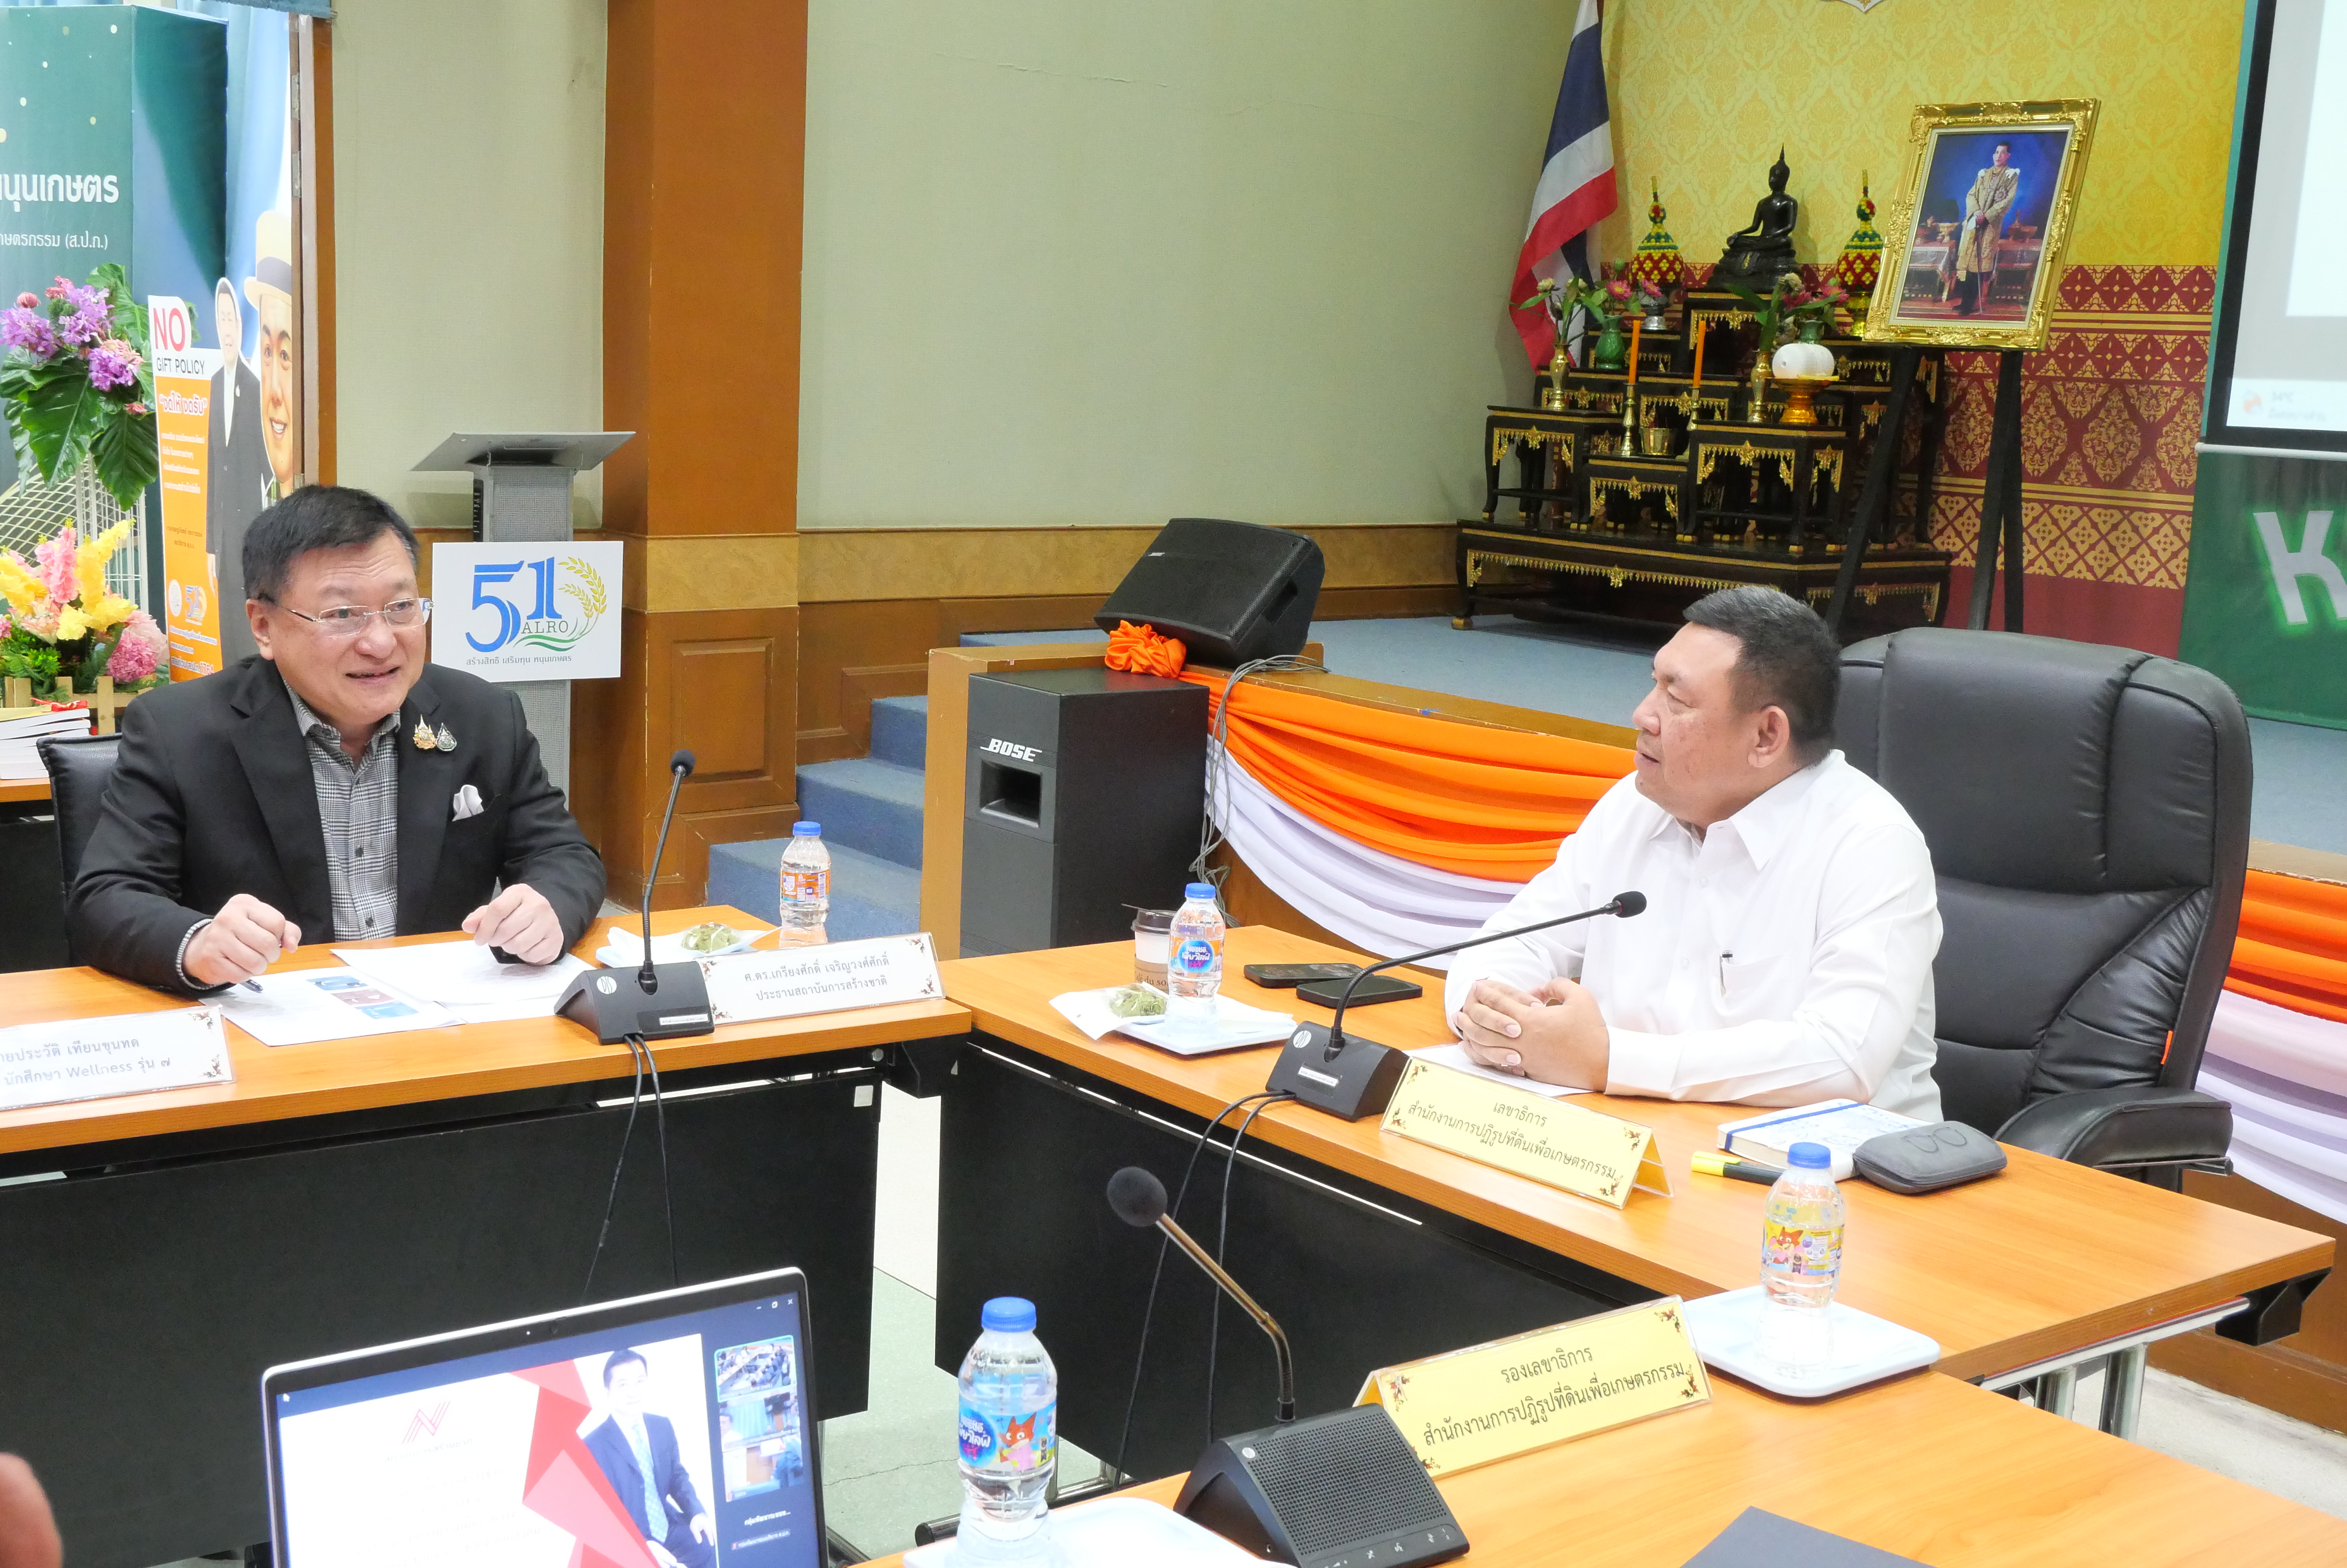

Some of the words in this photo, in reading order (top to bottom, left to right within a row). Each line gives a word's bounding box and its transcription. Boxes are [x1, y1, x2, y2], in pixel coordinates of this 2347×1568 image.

[0, 174, 119, 212] นุนเกษตร
[65, 231, 108, 250] (ส.ป.ก.)
[153, 307, 186, 352] NO
[156, 357, 172, 372] GIFT
[175, 358, 205, 375] POLICY
[465, 556, 562, 652] 51
[521, 620, 568, 634] ALRO
[466, 656, 499, 666] สร้างสิทธิ
[503, 656, 530, 665] เสริมทุน
[534, 655, 572, 665] หนุนเกษตร
[980, 738, 1043, 762] BOSE
[744, 959, 821, 981] ศ.ดร.เกรียงศักดิ์
[825, 951, 890, 974] เจริญวงศ์ศักดิ์
[756, 974, 888, 1001] ประธานสถาบันการสร้างชาติ
[67, 1038, 140, 1056] เทียนขุนทด
[4, 1069, 61, 1086] นักศึกษา
[66, 1063, 133, 1078] Wellness
[138, 1057, 155, 1073] รุ่น
[161, 1057, 171, 1068] ๗
[1493, 1102, 1548, 1127] เลขาธิการ
[1407, 1100, 1617, 1179] สำนักงานการปฏิรูปที่ดินเพื่อเกษตรกรรม
[1500, 1346, 1594, 1385] รองเลขาธิการ
[1423, 1360, 1685, 1447] สำนักงานการปฏิรูปที่ดินเพื่อเกษตรกรรม
